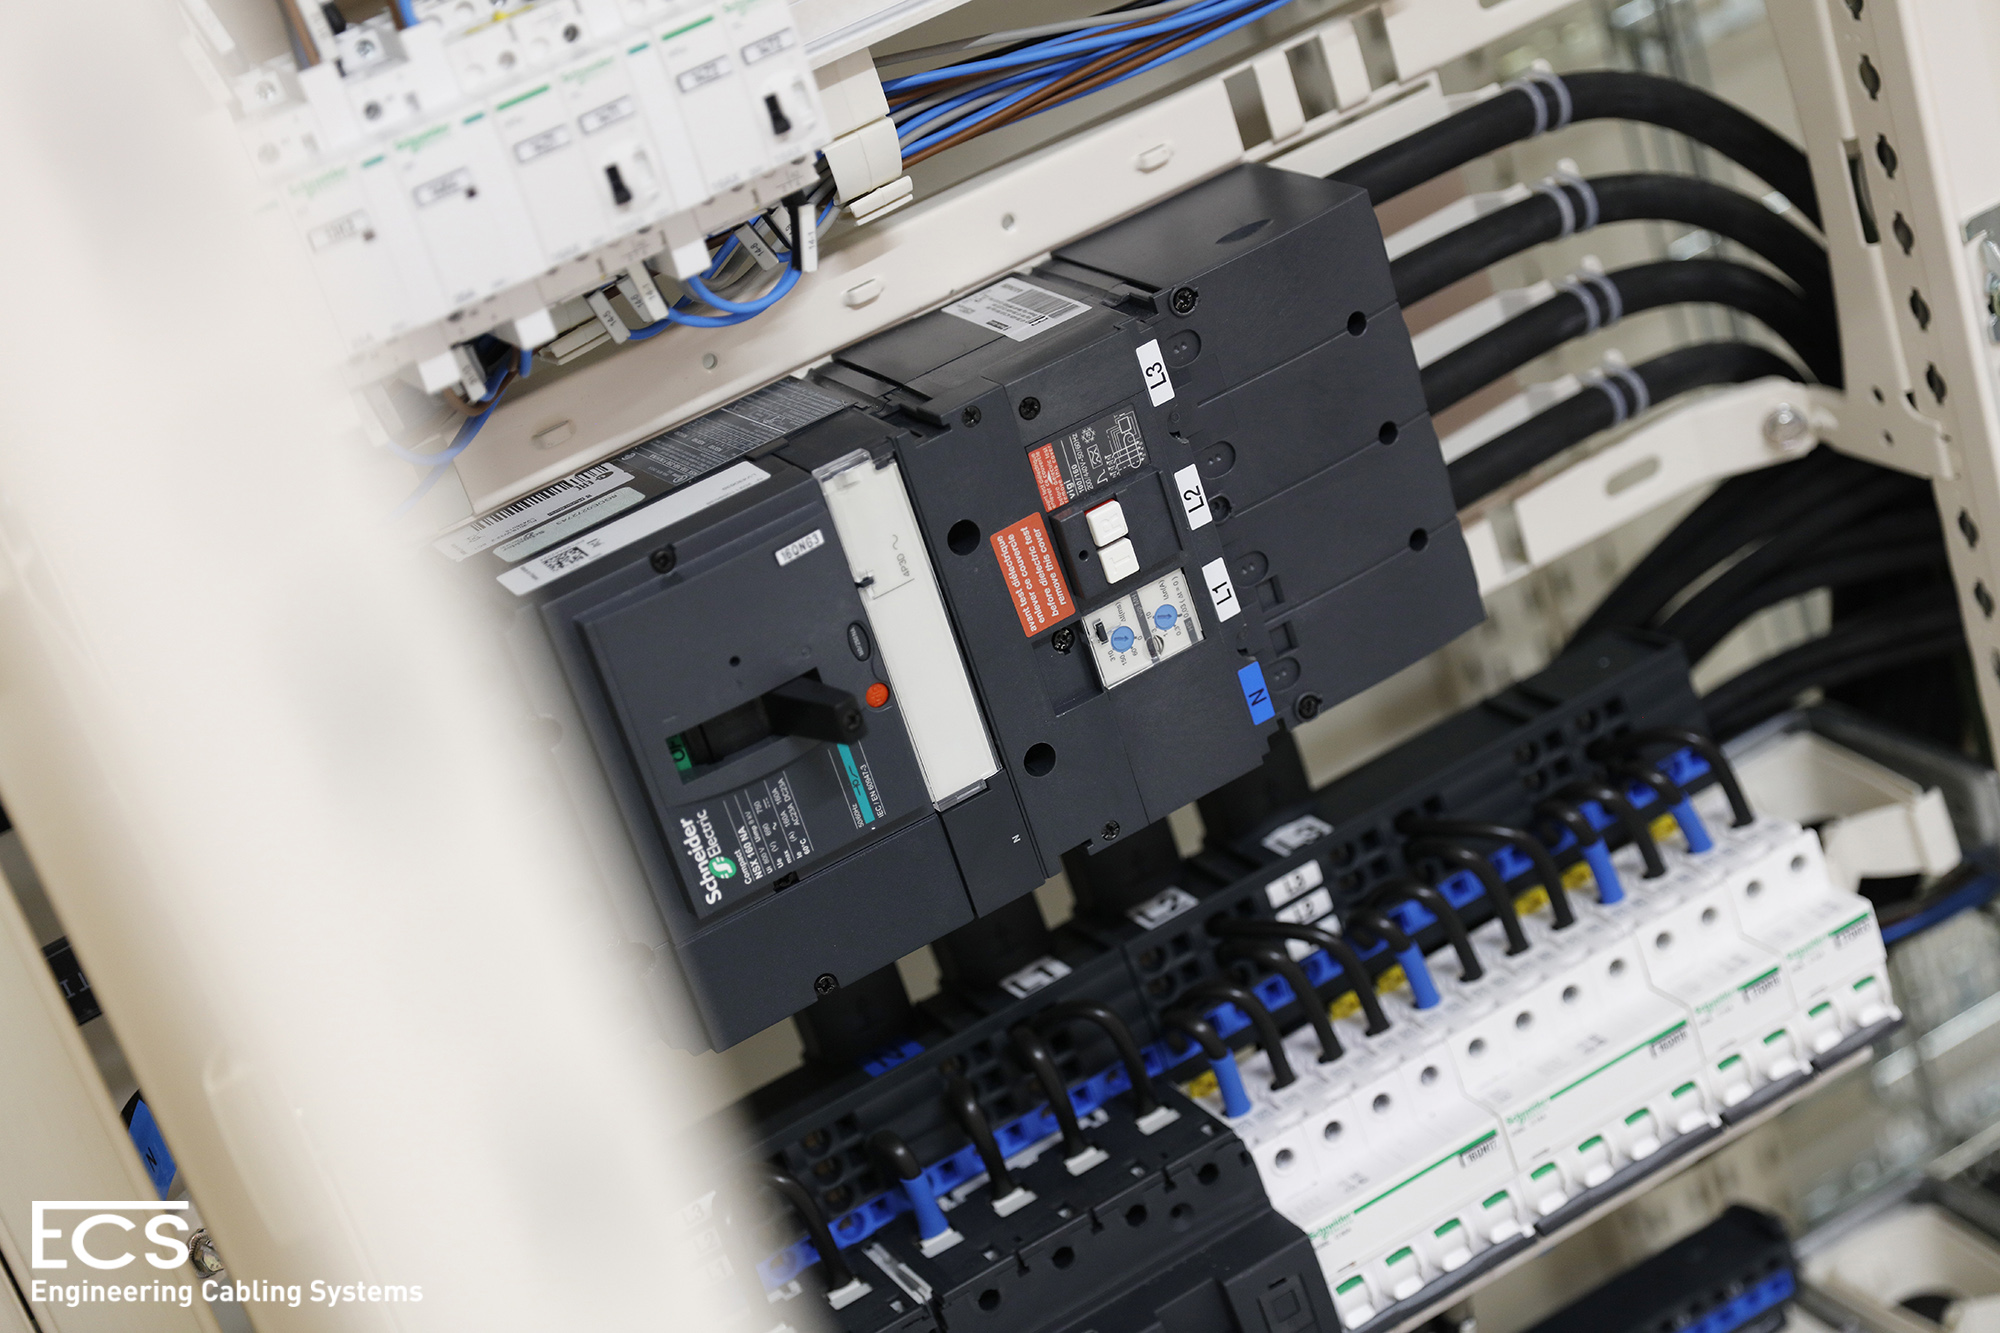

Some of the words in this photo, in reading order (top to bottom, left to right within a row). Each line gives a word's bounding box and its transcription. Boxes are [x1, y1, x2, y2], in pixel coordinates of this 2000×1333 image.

[749, 242, 765, 257] 14-8
[602, 310, 618, 327] 14-5
[1145, 361, 1167, 390] L3
[1071, 464, 1084, 493] 100/160
[1183, 484, 1205, 513] L2
[1020, 526, 1033, 545] test
[1033, 528, 1047, 553] cover
[997, 535, 1021, 588] diélectrique
[1008, 534, 1028, 577] couvercle
[1043, 554, 1054, 572] this
[1028, 545, 1048, 587] dielectric
[1024, 578, 1033, 590] ce
[1050, 572, 1067, 605] remove
[1212, 580, 1233, 606] L1
[1015, 588, 1028, 607] test
[1044, 587, 1059, 617] before
[1028, 591, 1045, 624] enlever
[1145, 611, 1152, 620] 10
[1022, 606, 1037, 632] avant
[1107, 649, 1116, 662] 310
[1119, 654, 1127, 666] 150
[1130, 648, 1138, 656] 60
[1249, 687, 1267, 707] N
[860, 764, 874, 791] 60947-3
[772, 787, 782, 805] 160A
[778, 778, 791, 802] DC23A
[869, 790, 878, 802] EN
[780, 810, 790, 828] 160A
[787, 802, 800, 826] AC23A
[874, 805, 884, 818] IEC
[696, 809, 722, 858] Electric
[738, 826, 749, 842] NA
[751, 825, 761, 843] Uimp
[762, 823, 772, 836] 690
[788, 831, 798, 842] (A)
[1012, 834, 1021, 844] N
[743, 842, 755, 858] 160
[769, 841, 779, 852] (V)
[680, 818, 722, 905] Schneider
[776, 858, 784, 868] Ue
[784, 850, 792, 864] max
[734, 849, 752, 885] Compact
[749, 858, 763, 880] NSX
[1138, 894, 1179, 923] L2
[1011, 966, 1054, 997] L1
[144, 1146, 158, 1172] N
